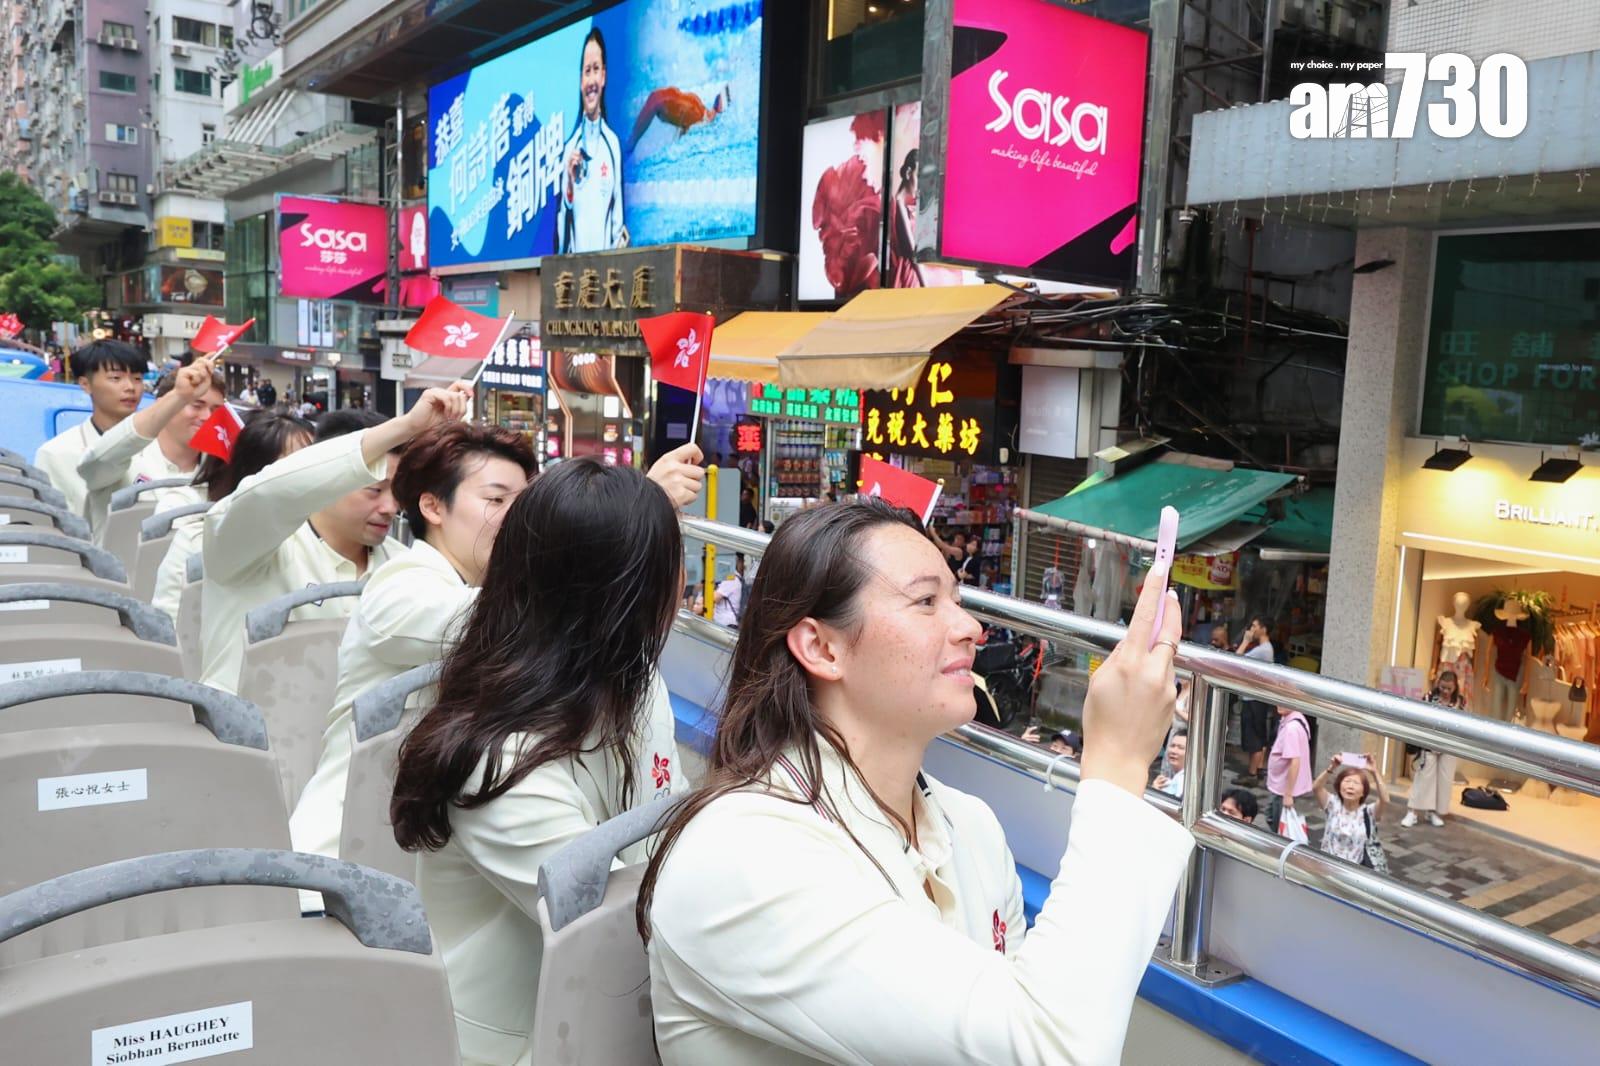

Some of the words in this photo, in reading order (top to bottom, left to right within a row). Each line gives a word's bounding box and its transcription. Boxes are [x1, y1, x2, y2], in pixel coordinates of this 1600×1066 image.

[434, 92, 465, 167] 恭喜
[506, 111, 565, 241] 銅牌
[991, 144, 1028, 169] making
[1031, 149, 1051, 172] life
[1052, 154, 1099, 180] beautiful
[546, 320, 600, 337] CHUNGKING
[601, 320, 642, 338] MANSIO
[1437, 360, 1519, 387] SHOP
[106, 1047, 162, 1065] Siobhan
[167, 1031, 240, 1053] Bernadette
[113, 1035, 145, 1049] Miss
[150, 1016, 230, 1042] HAUGHEY
